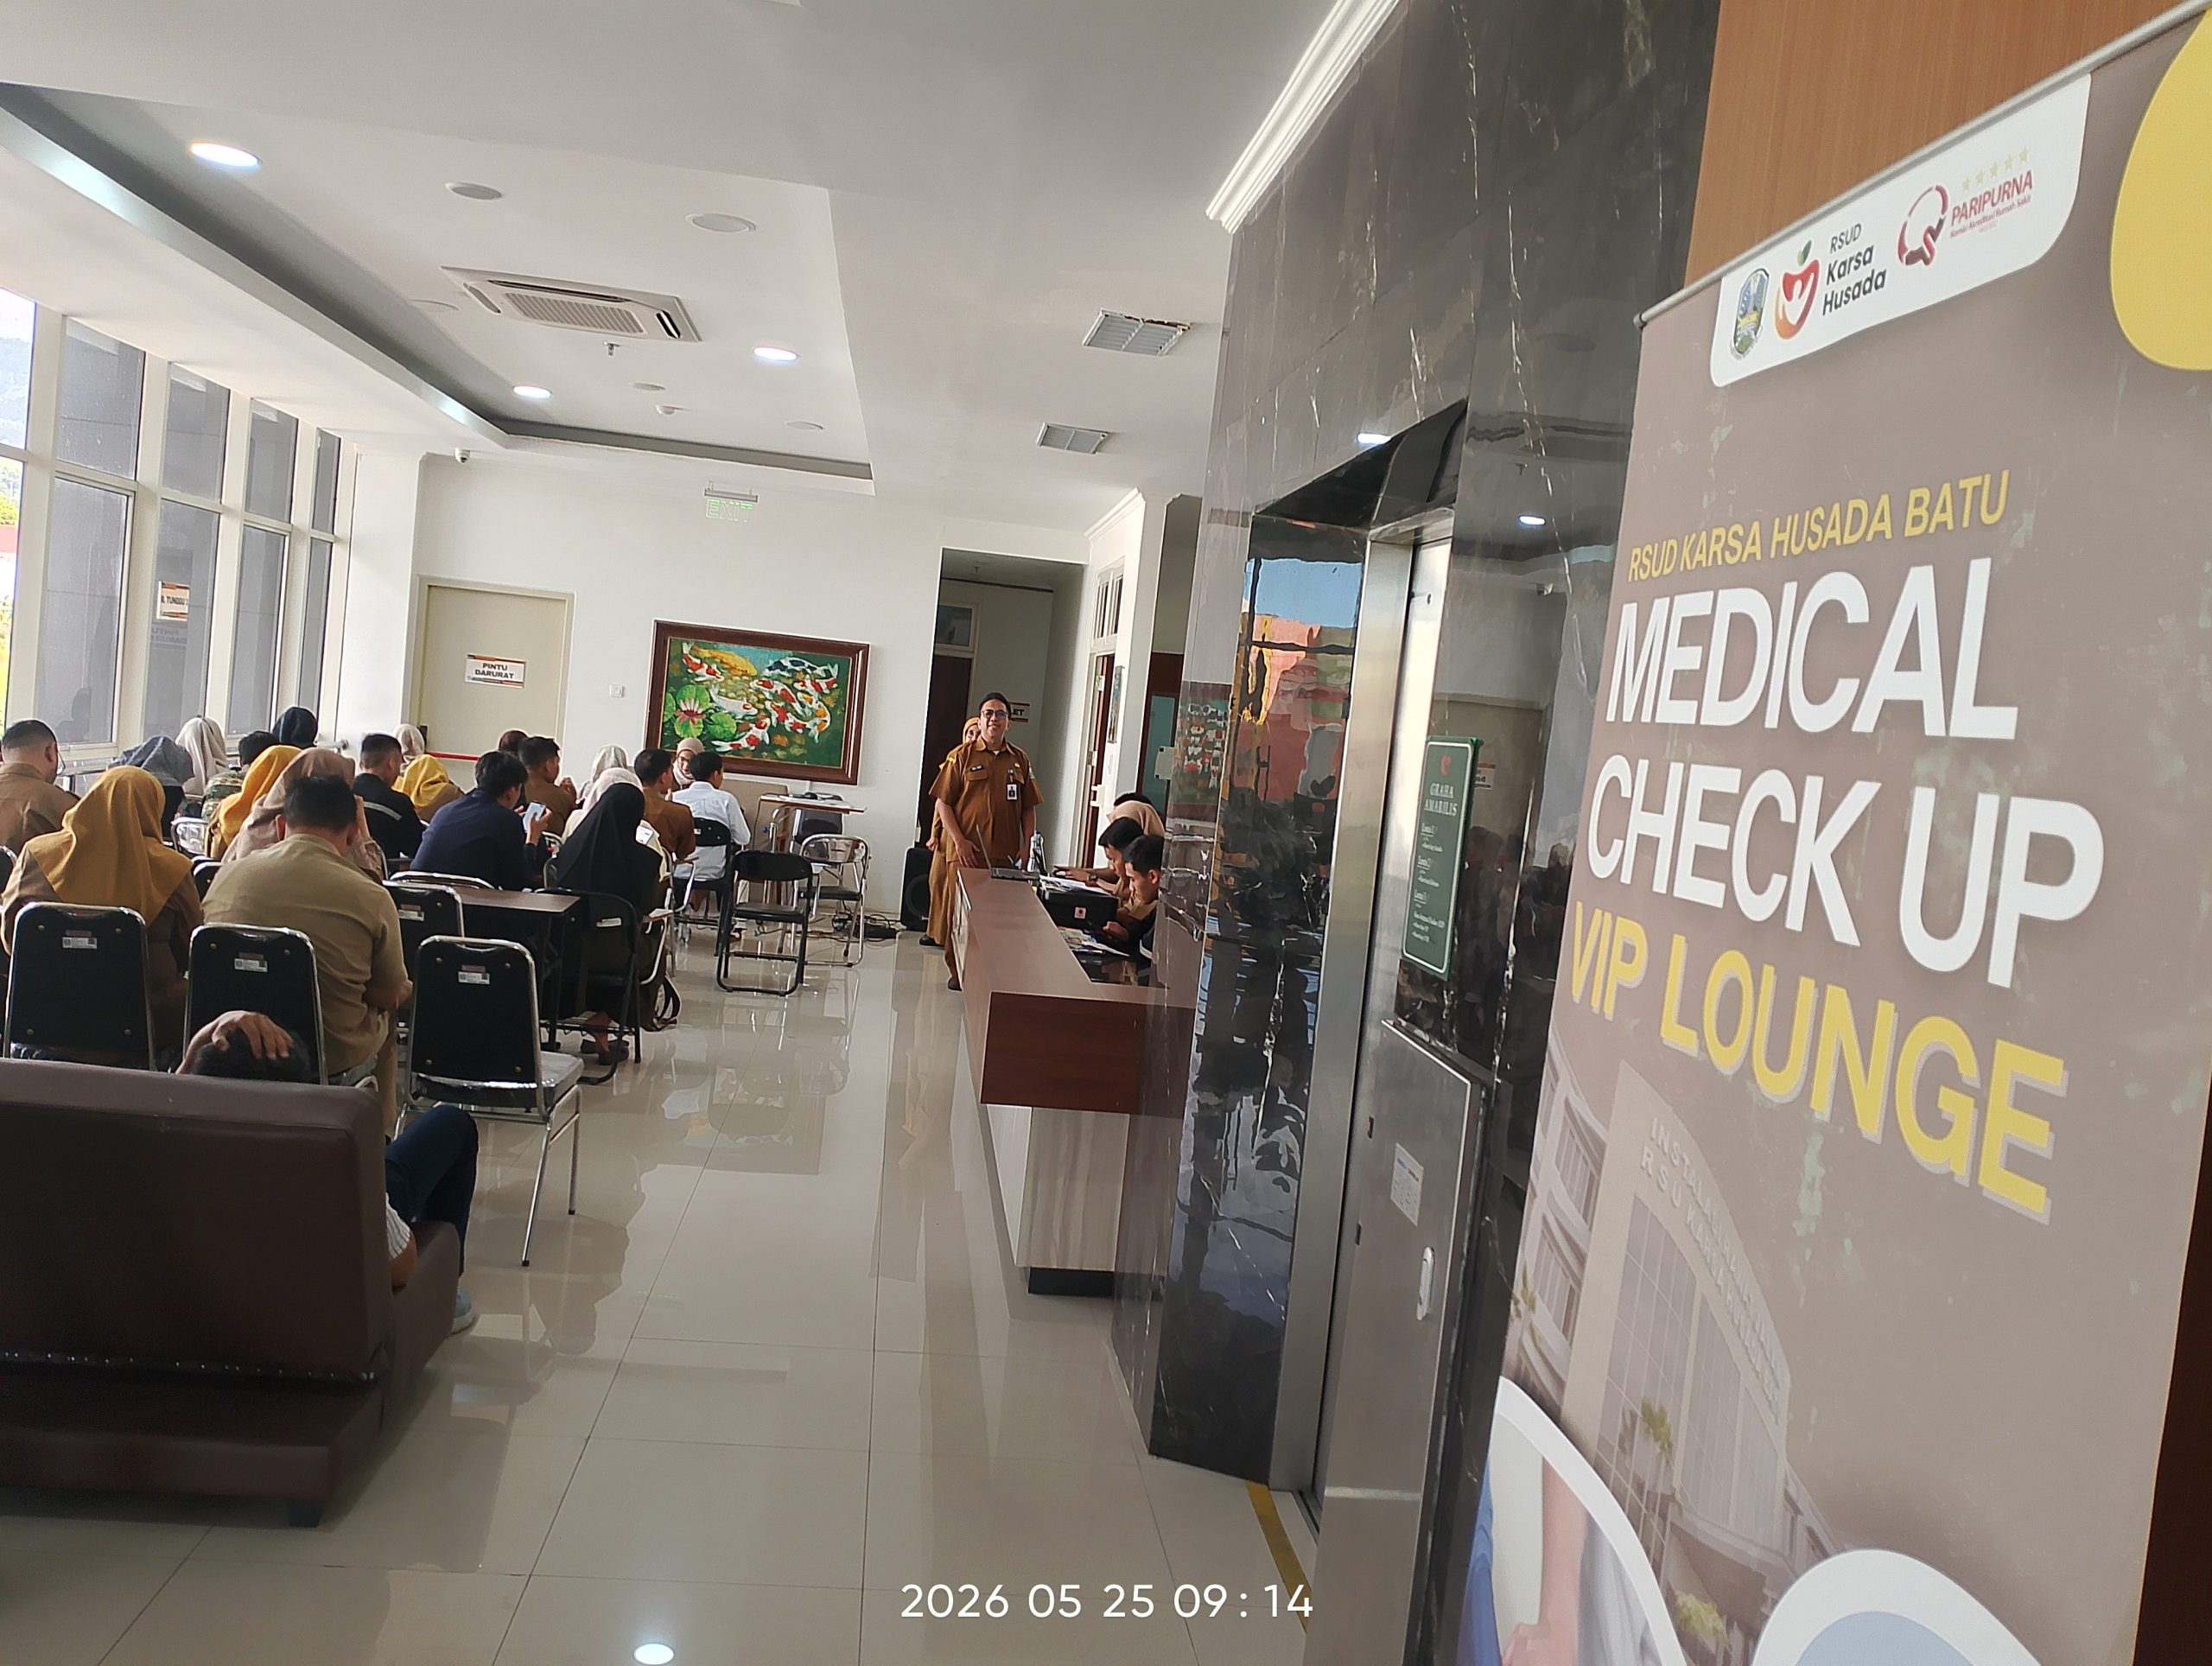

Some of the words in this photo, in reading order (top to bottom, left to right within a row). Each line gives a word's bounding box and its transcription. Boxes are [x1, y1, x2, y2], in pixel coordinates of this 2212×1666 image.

[1951, 169, 2033, 226] PARIPURNA
[1830, 223, 1862, 254] RSUD
[1826, 245, 1873, 285] Karsa
[1822, 269, 1887, 316] Husada
[706, 498, 753, 523] EXIT
[1628, 539, 1679, 582] RSUD
[1680, 521, 1762, 572] KARSA
[1770, 493, 1893, 559] HUSADA
[1904, 469, 2011, 538] BATU
[474, 669, 515, 679] DARURAT
[482, 662, 508, 671] PINTU
[1605, 557, 2018, 740] MEDICAL
[1586, 754, 1882, 947] CHECK
[1899, 786, 2105, 989] UP
[1569, 900, 1648, 1019] VIP
[1659, 932, 2067, 1218] LOUNGE
[1640, 1145, 1681, 1210] RSU
